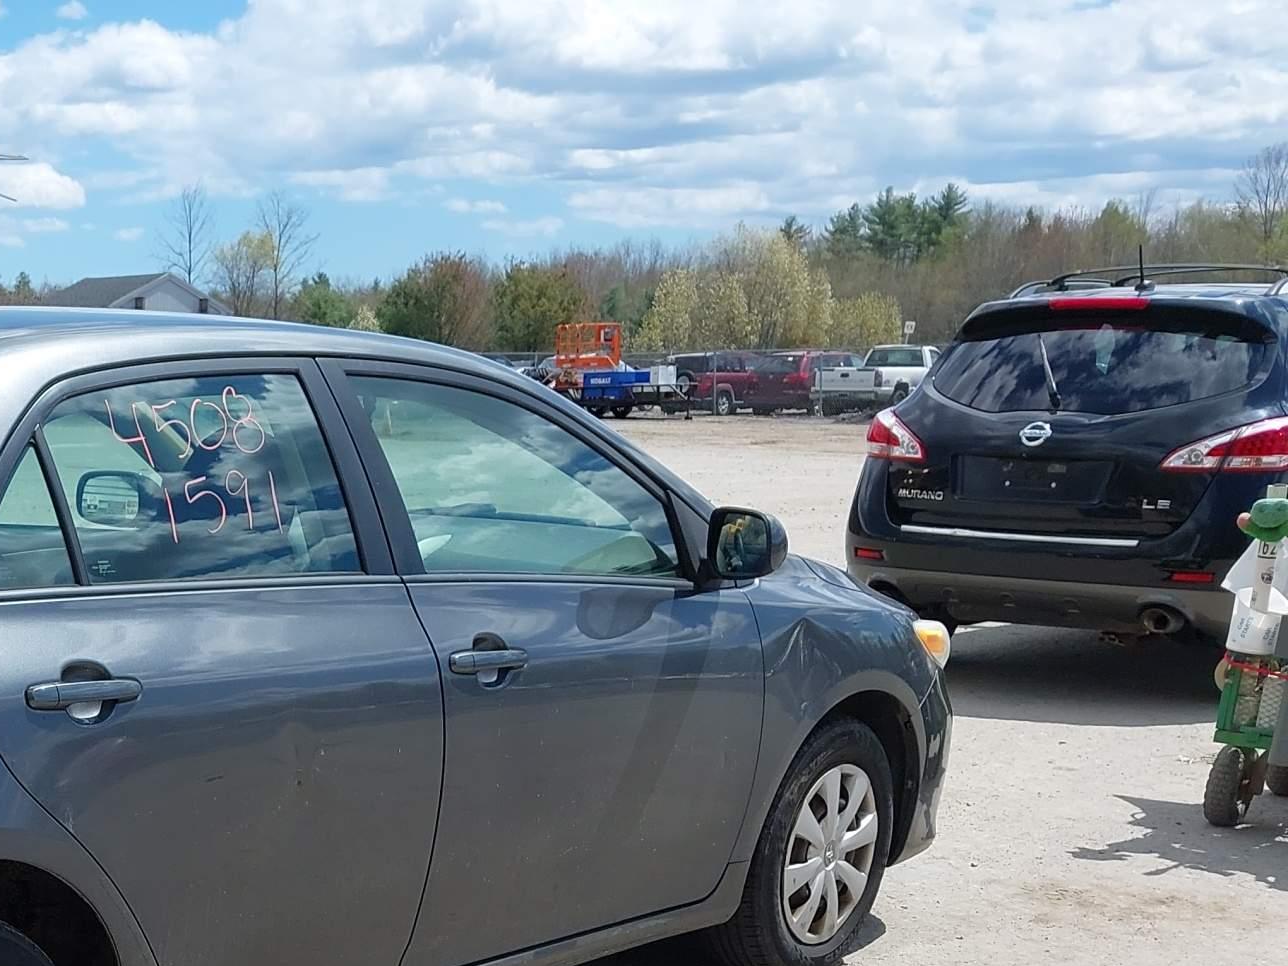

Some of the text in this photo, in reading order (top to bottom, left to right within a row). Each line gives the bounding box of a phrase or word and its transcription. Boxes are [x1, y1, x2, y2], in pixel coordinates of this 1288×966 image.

[104, 386, 265, 464] 4508
[164, 469, 284, 544] 1591
[897, 488, 944, 501] MURANO
[1142, 498, 1172, 510] LE
